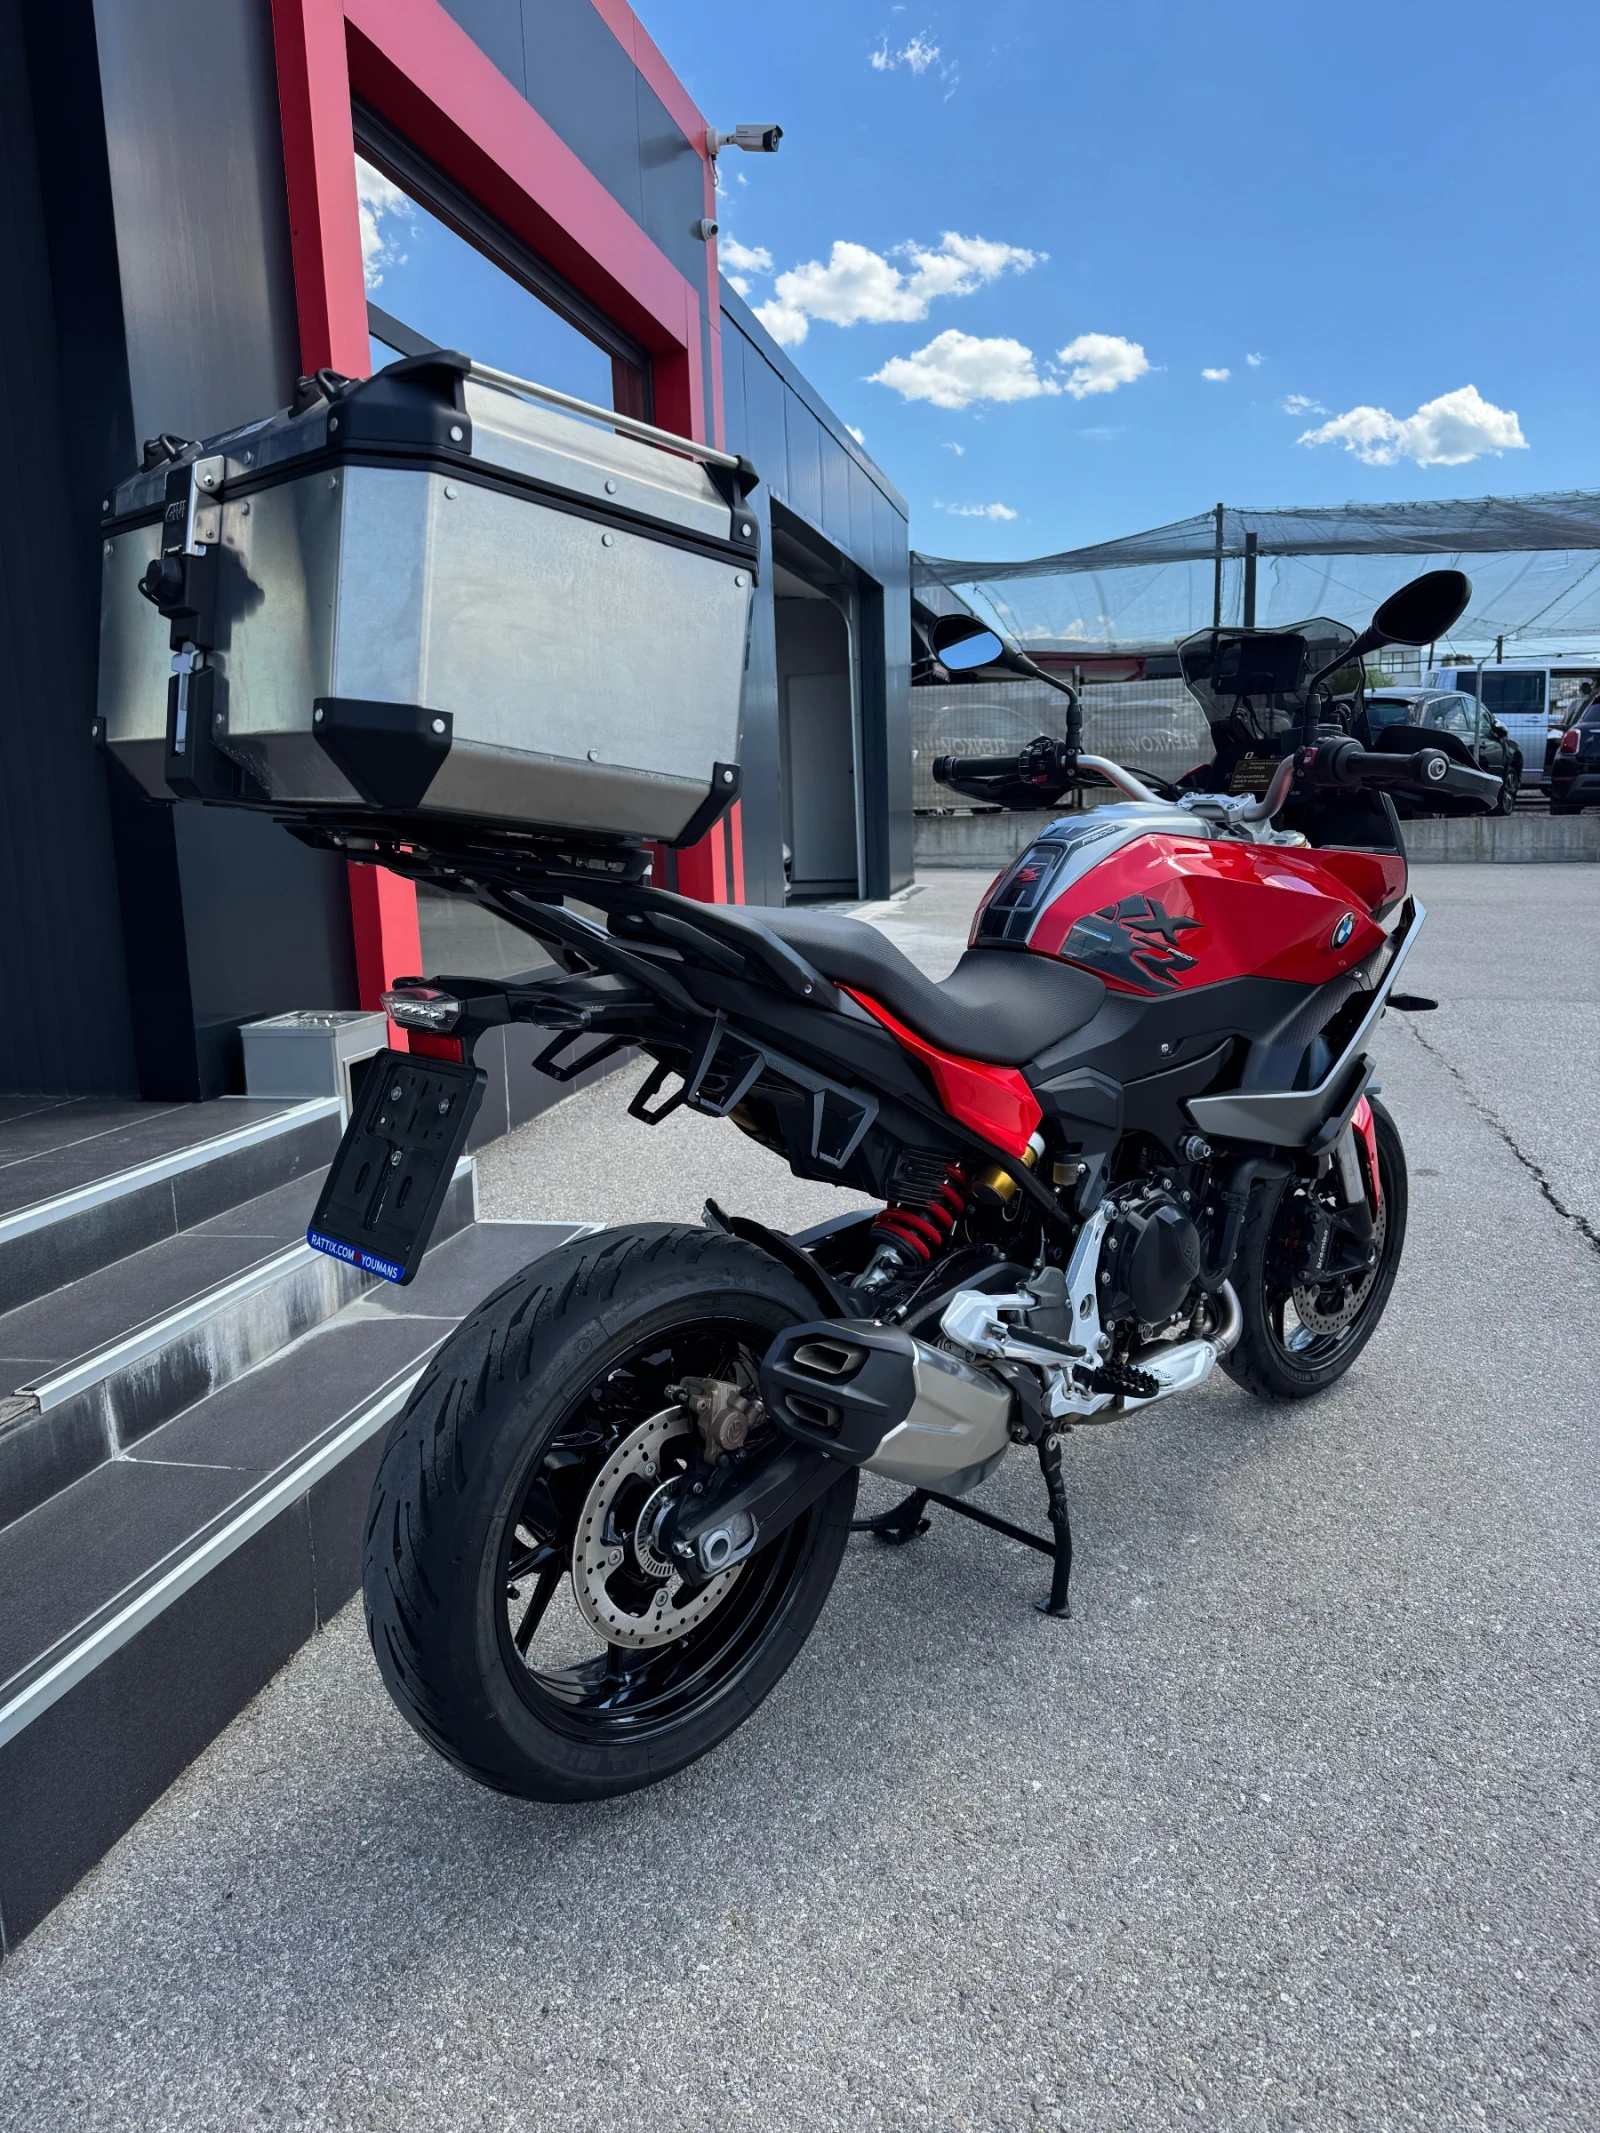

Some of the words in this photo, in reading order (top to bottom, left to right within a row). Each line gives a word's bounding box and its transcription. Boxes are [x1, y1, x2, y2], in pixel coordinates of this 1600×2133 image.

[1082, 826, 1116, 845] F900
[311, 1234, 354, 1261] RATTIX.COM
[361, 1254, 398, 1279] YOUMANS
[1315, 1229, 1328, 1269] brembo
